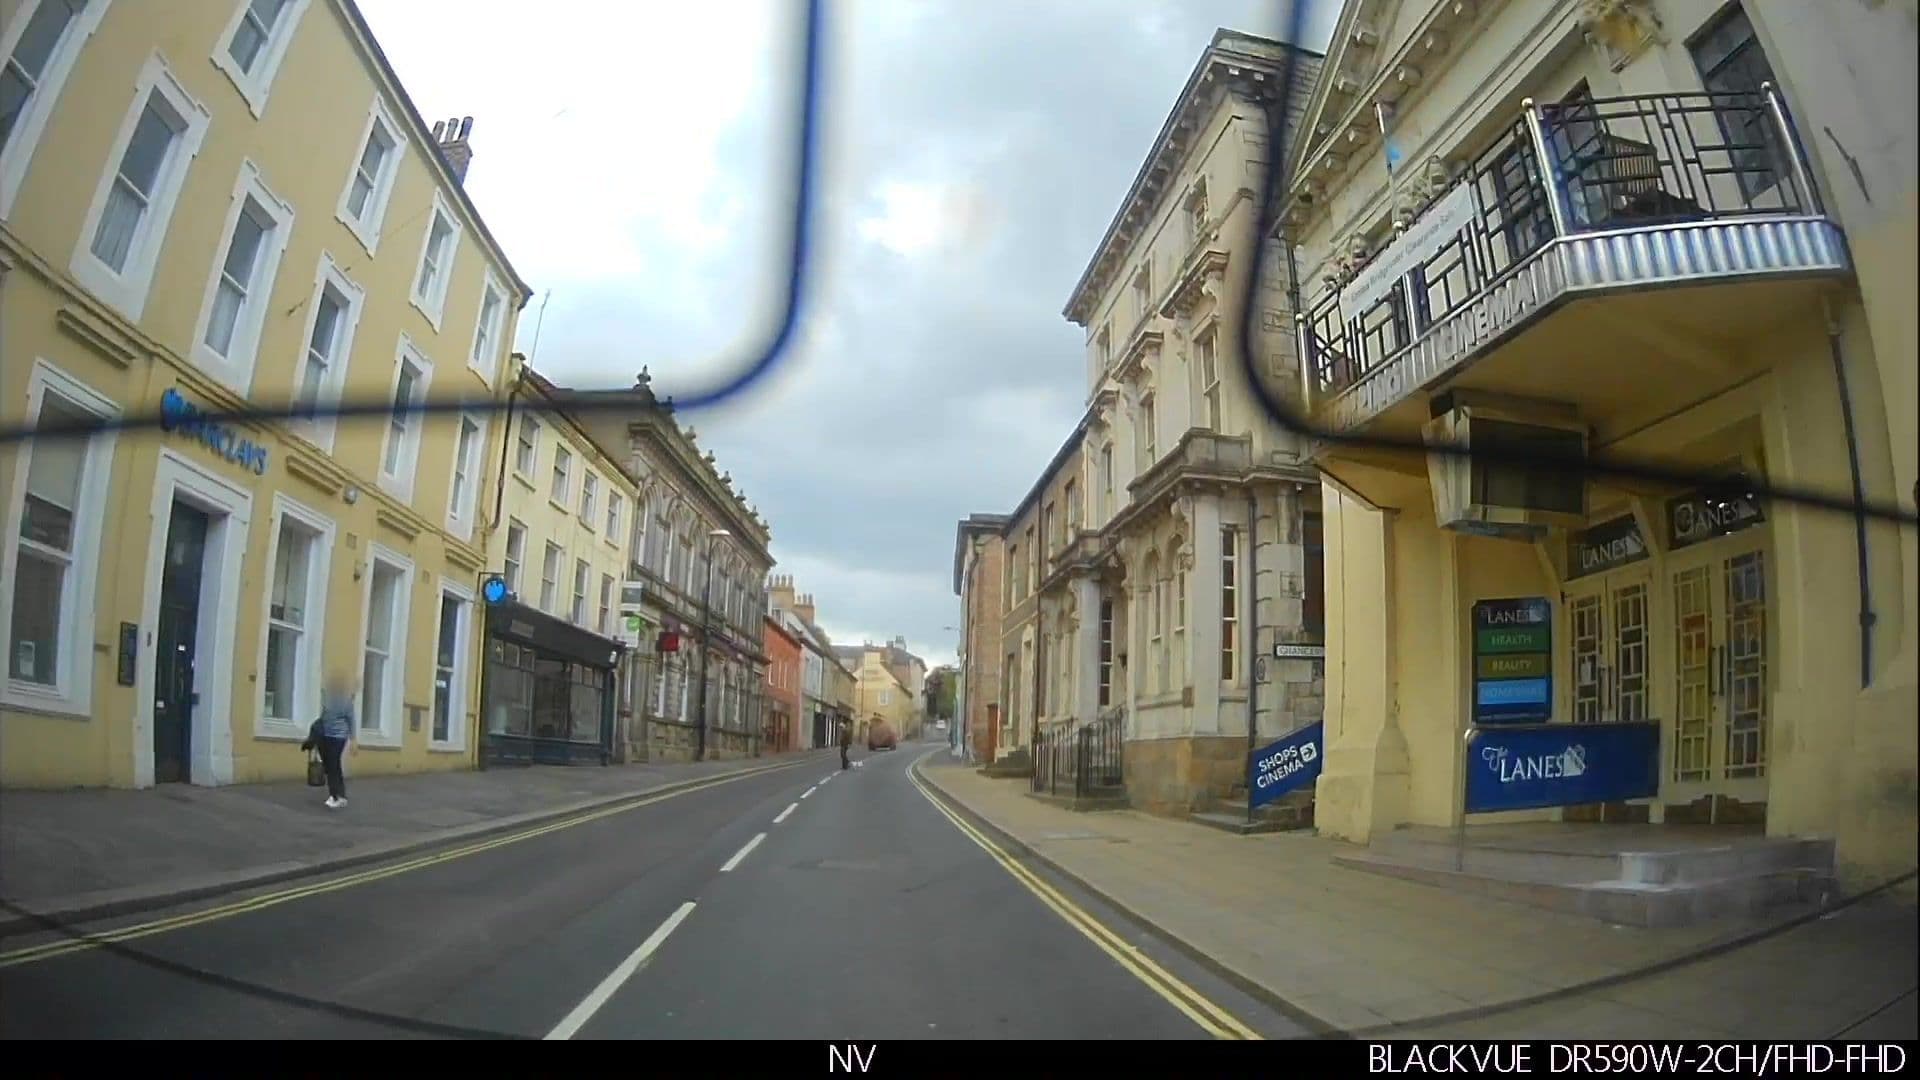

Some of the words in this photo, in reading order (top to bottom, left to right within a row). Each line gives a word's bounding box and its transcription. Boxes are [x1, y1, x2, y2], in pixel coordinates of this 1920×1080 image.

[1491, 634, 1533, 646] HEALTH
[1492, 660, 1532, 672] BEAUTY
[1258, 745, 1298, 772] SHOPS
[1500, 755, 1564, 783] LANES
[1256, 759, 1304, 788] CINEMA
